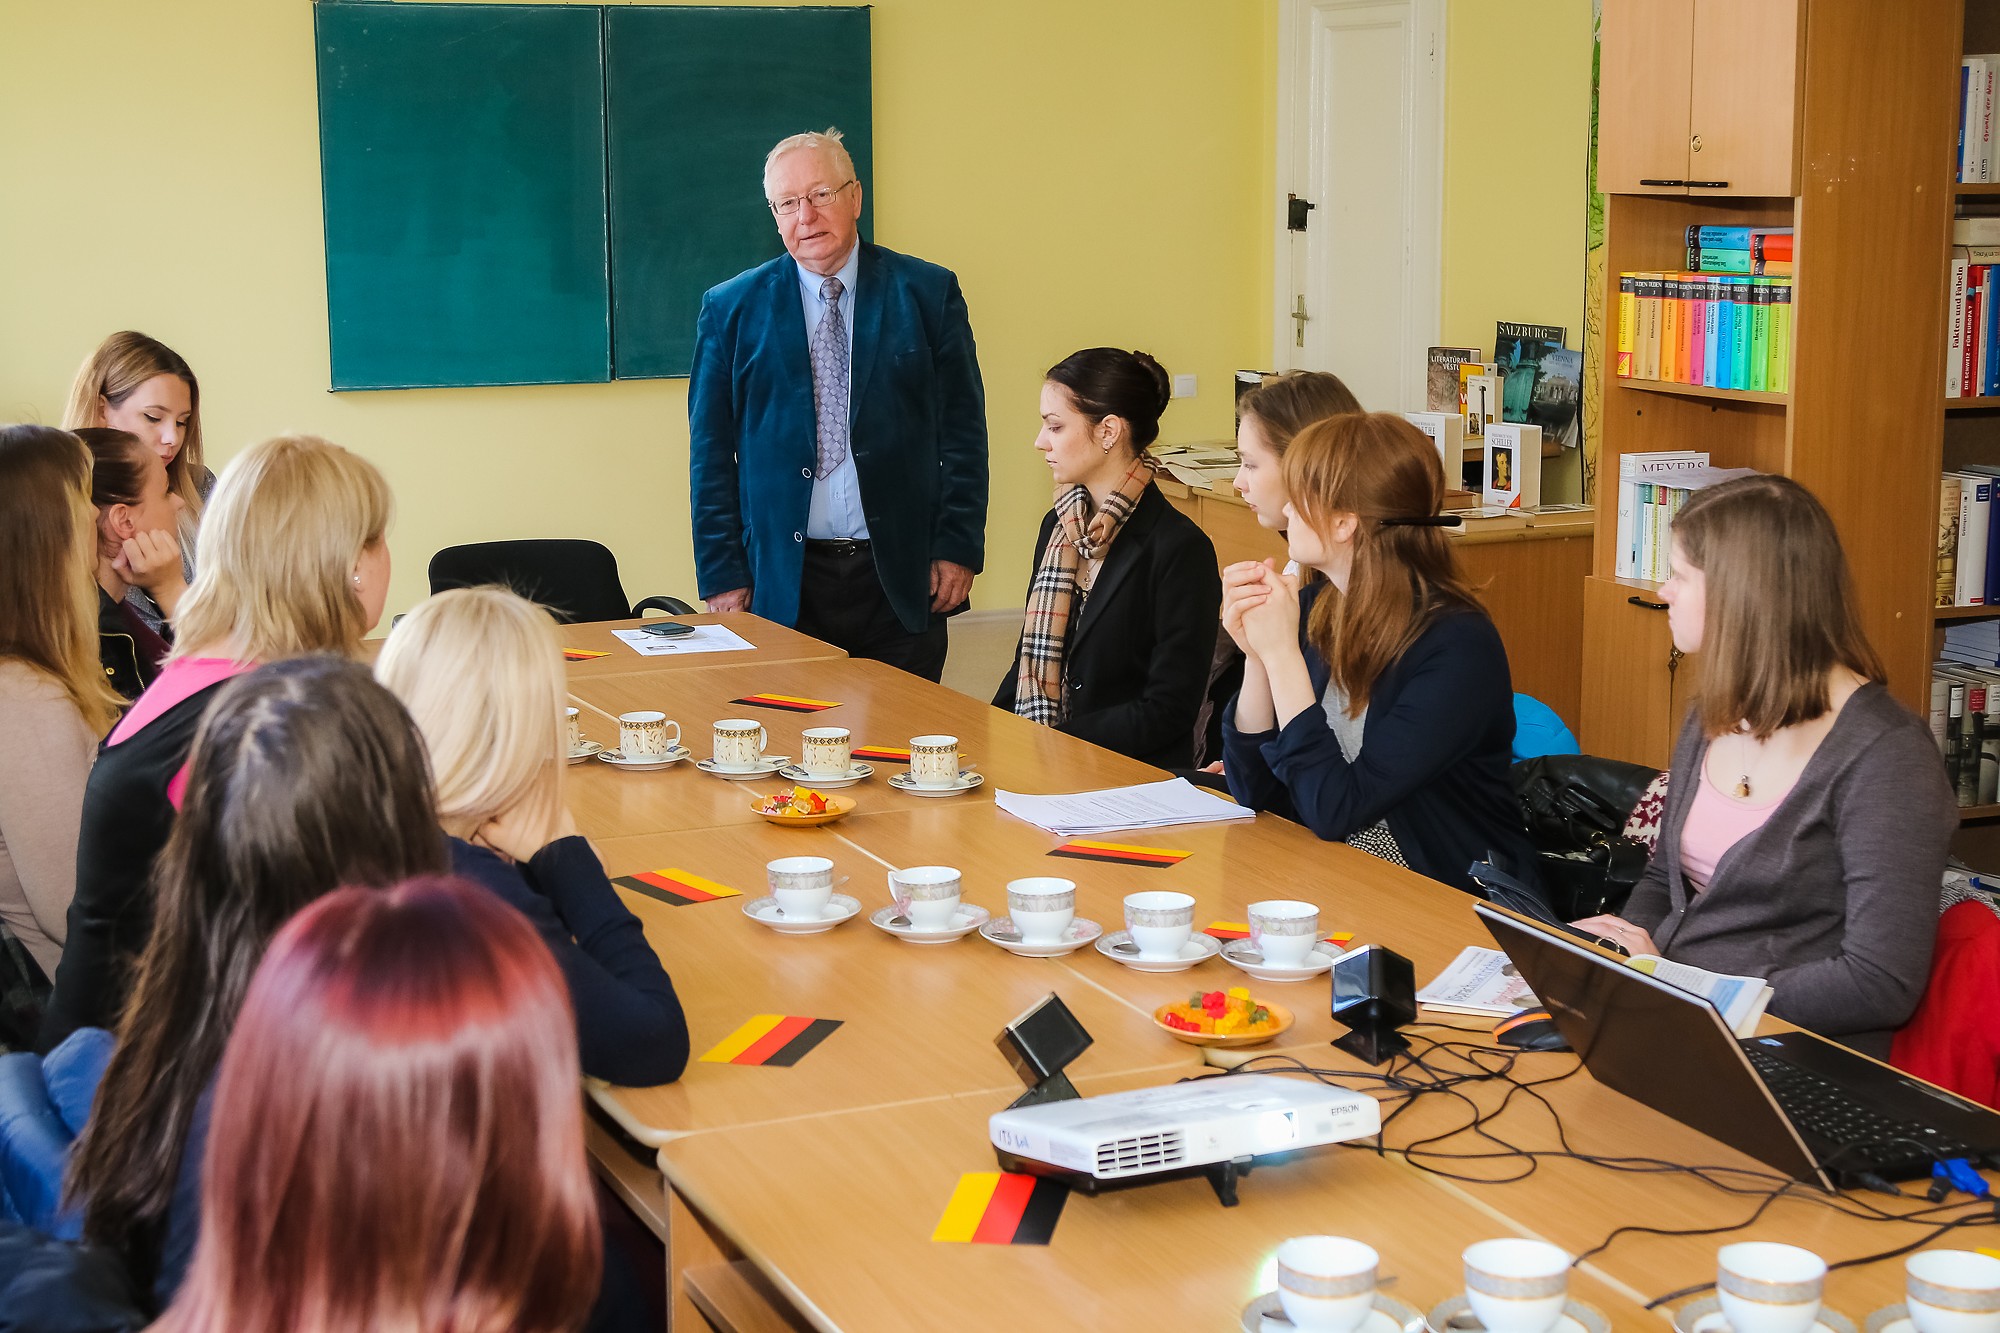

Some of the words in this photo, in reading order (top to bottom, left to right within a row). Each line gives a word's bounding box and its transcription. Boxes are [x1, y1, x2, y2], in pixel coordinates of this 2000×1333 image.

[1983, 112, 1991, 142] Chronik
[1955, 266, 1964, 296] Fabeln
[1499, 324, 1548, 339] SALZBURG
[1621, 296, 1629, 345] Rechtschreibung
[1952, 318, 1961, 349] Fakten
[1491, 437, 1513, 448] SCHILLER
[1331, 1103, 1360, 1116] EPSON
